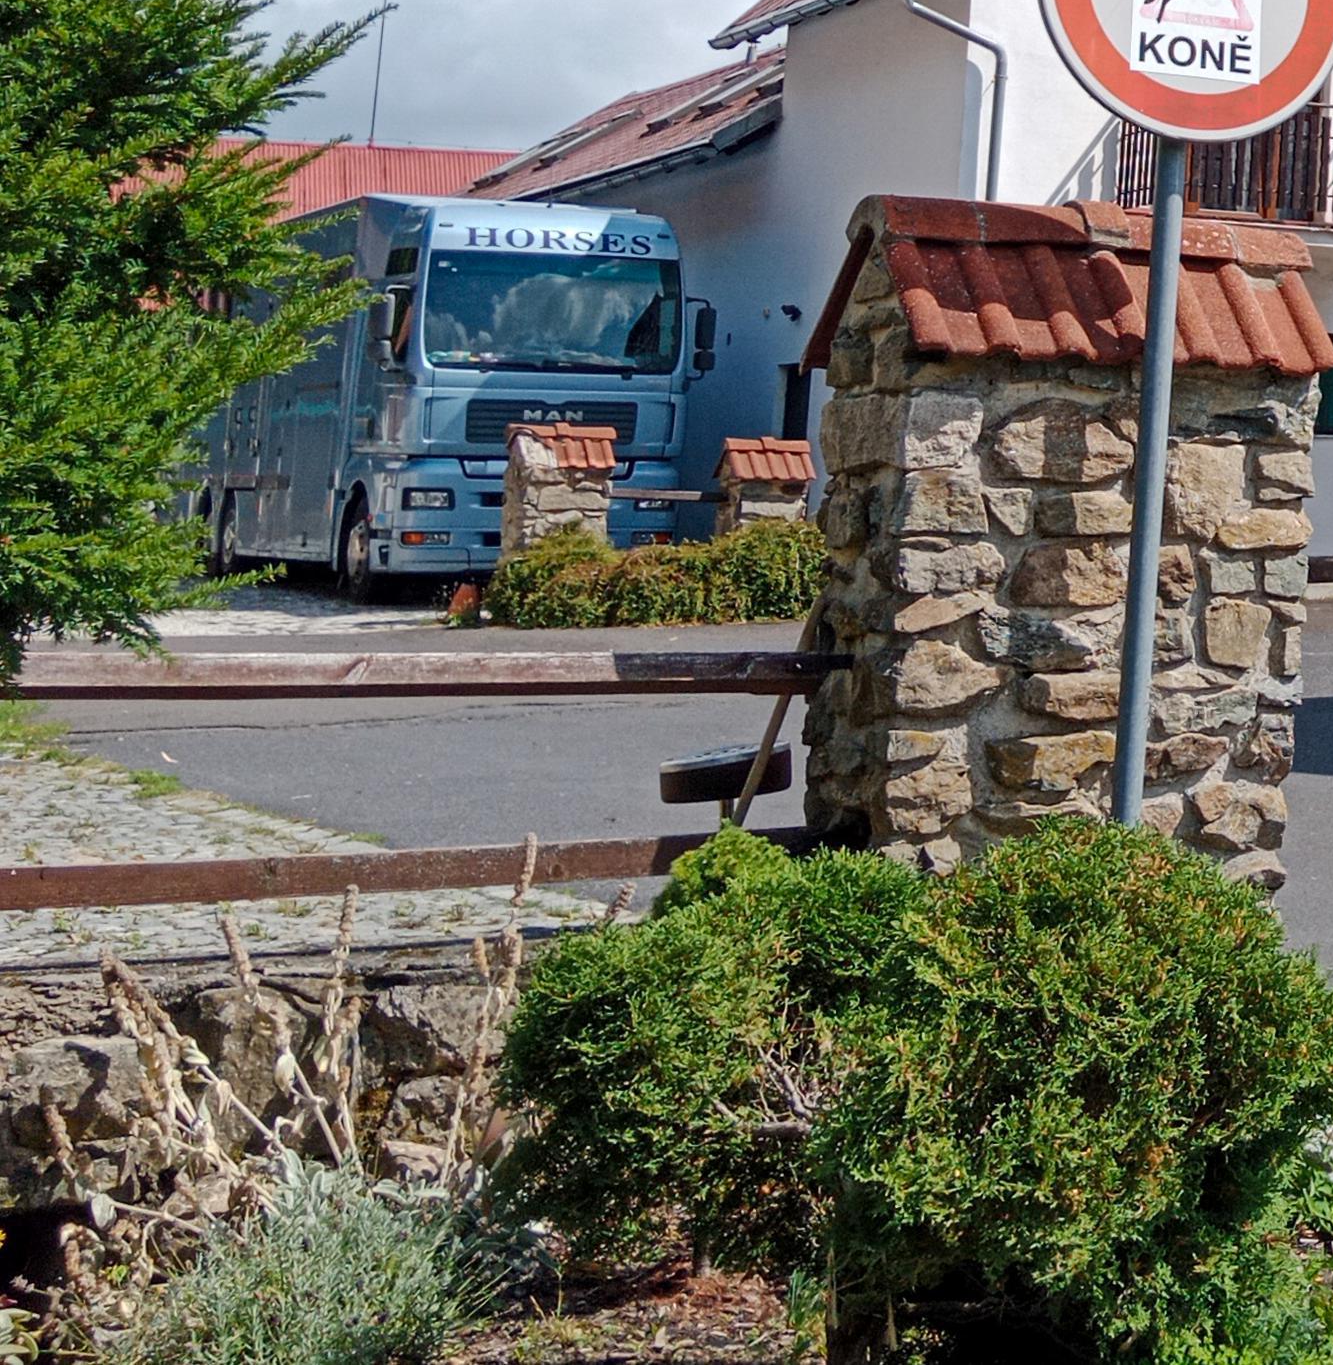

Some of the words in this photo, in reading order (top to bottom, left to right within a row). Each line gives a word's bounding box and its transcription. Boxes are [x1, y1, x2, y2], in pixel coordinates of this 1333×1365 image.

[1138, 31, 1252, 74] KONĚ
[465, 225, 652, 256] HORSES
[523, 409, 584, 422] MAN
